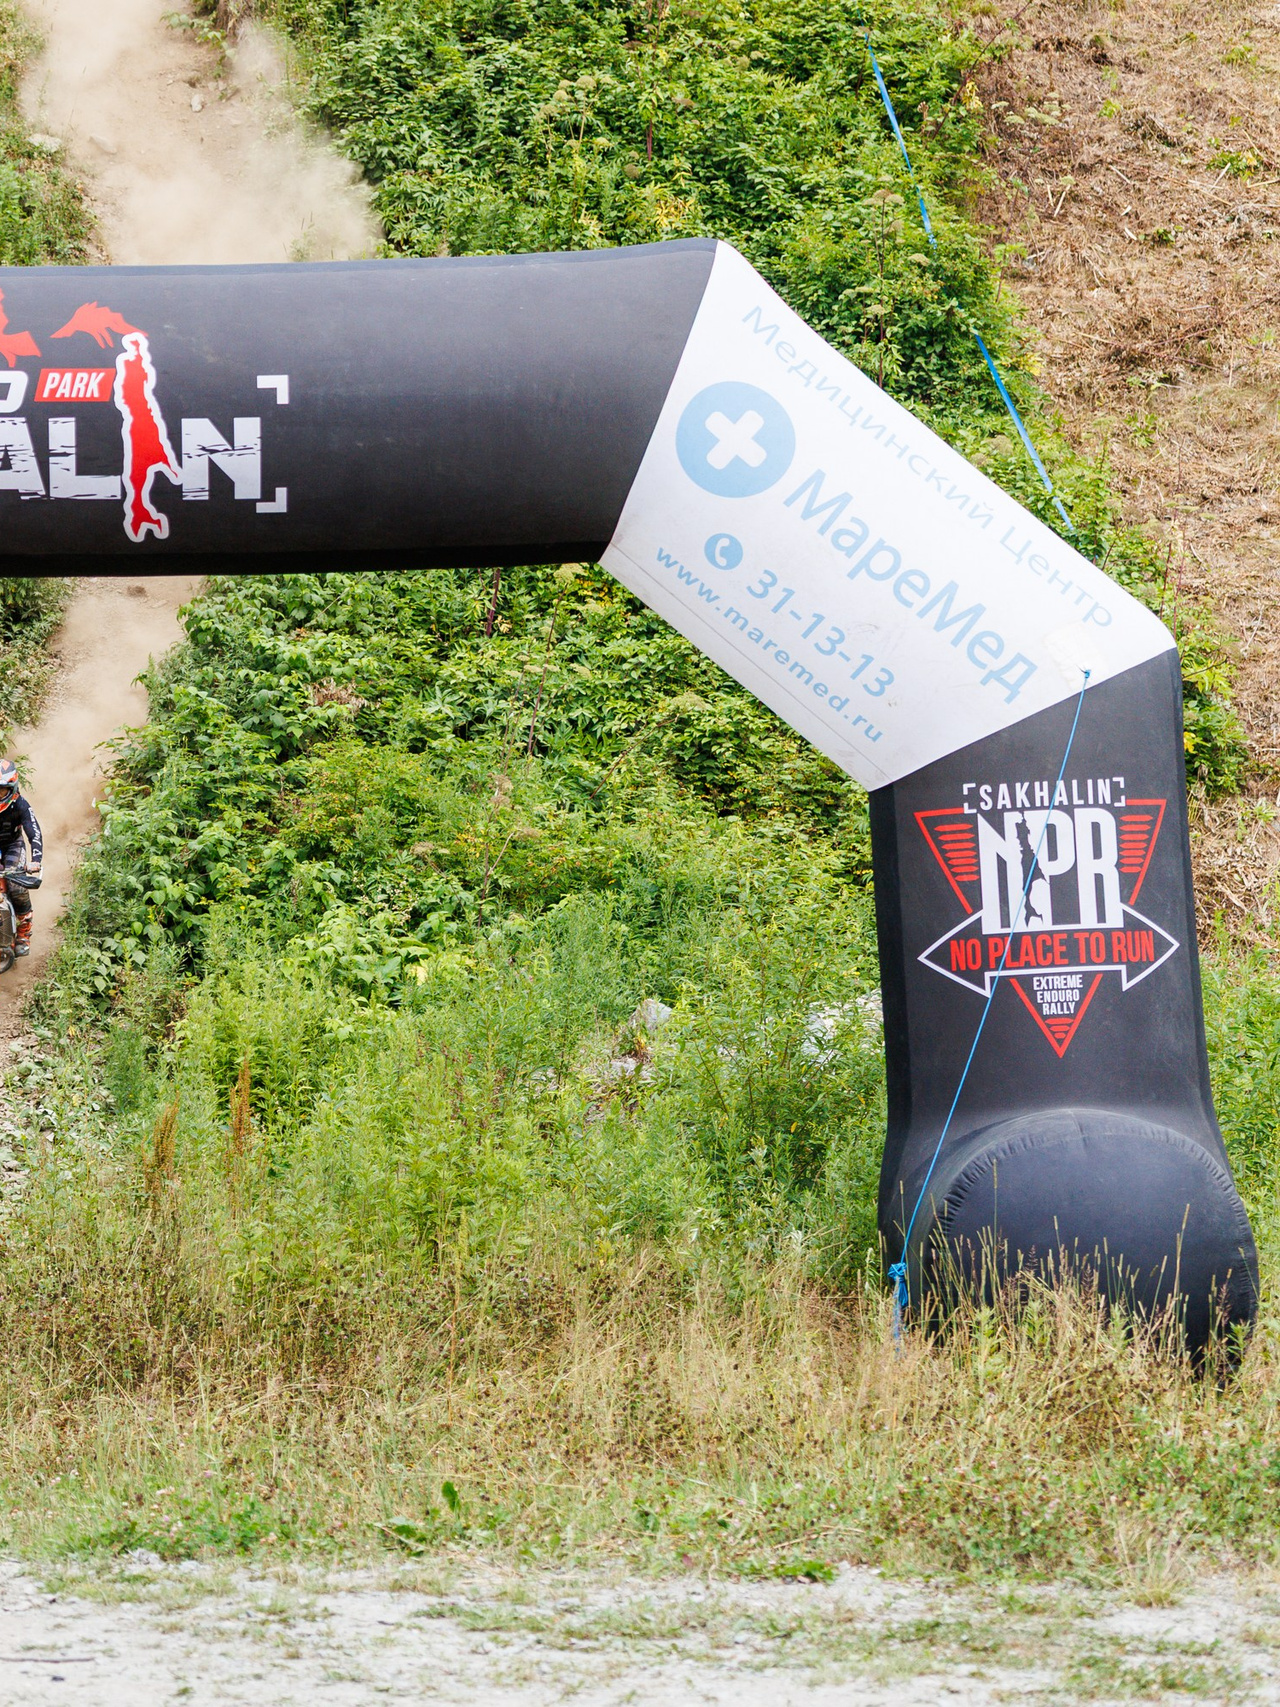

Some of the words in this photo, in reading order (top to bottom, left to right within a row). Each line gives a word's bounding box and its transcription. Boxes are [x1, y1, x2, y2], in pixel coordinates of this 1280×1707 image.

[42, 373, 103, 399] PARK
[741, 305, 994, 530] Медицинский
[1000, 525, 1114, 630] Центр
[782, 469, 1039, 706] МареМед
[654, 546, 884, 743] www.maremed.ru
[745, 568, 896, 699] 31-13-13
[979, 778, 1112, 811] SAKHALIN
[976, 807, 1125, 935] NPR
[950, 938, 982, 971] NO
[988, 933, 1069, 969] PLACE
[1074, 932, 1106, 963] TO
[1111, 931, 1155, 963] RUN
[1033, 974, 1084, 991] EXTREME
[1036, 989, 1080, 1004] ENDURO
[1042, 1001, 1076, 1016] RALLY
